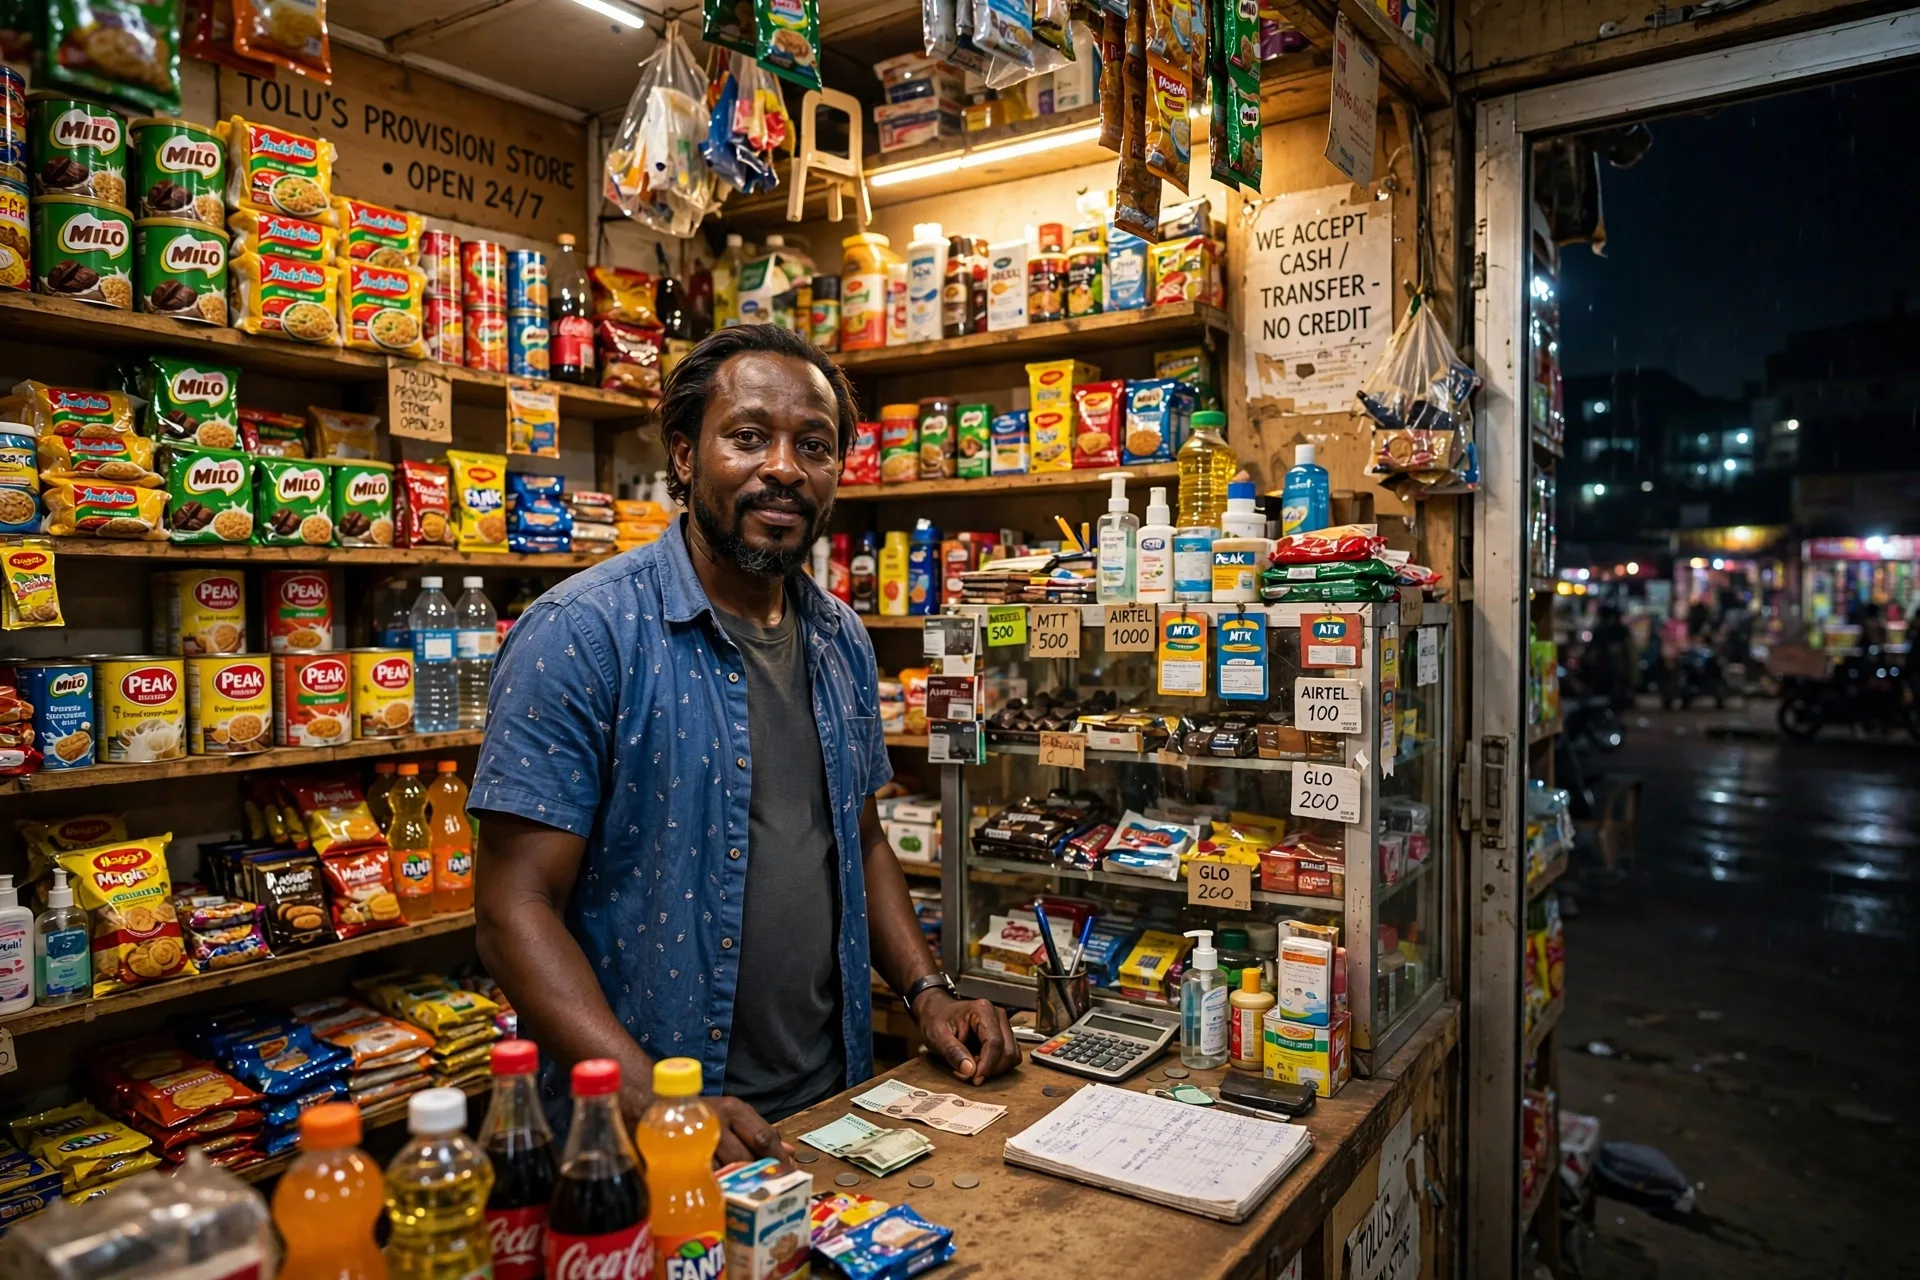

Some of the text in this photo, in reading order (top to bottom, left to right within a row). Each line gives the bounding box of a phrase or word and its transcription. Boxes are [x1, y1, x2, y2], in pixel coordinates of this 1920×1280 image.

[60, 119, 116, 145] MILO
[237, 73, 576, 191] TOLU'S PROVISION STORE
[165, 145, 217, 169] MILO
[408, 160, 544, 220] OPEN 24/7
[68, 223, 125, 248] MILO
[1255, 212, 1368, 251] WE ACCEPT
[171, 244, 221, 267] MILO
[1279, 246, 1332, 275] CASH
[1260, 273, 1366, 309] TRANSFER
[1263, 305, 1373, 341] NO CREDIT
[177, 378, 224, 397] MILO
[192, 467, 239, 486] MILO
[282, 476, 321, 494] MILO
[353, 480, 388, 498] MILO
[200, 582, 238, 600] PEAK
[287, 581, 324, 599] PEAK
[1037, 612, 1068, 629] MTT
[1109, 609, 1153, 624] AIRTEL
[992, 625, 1014, 640] 500
[1038, 632, 1069, 649] 500
[1112, 628, 1150, 645] 1000
[220, 670, 263, 689] PEAK
[306, 665, 344, 685] PEAK
[376, 663, 410, 681] PEAK
[55, 678, 85, 692] MILO
[128, 673, 174, 694] PEAK
[1301, 686, 1350, 701] AIRTEL
[1308, 704, 1339, 722] 100
[1303, 770, 1333, 786] GLO
[1299, 791, 1339, 811] 200
[1199, 865, 1230, 881] GLO
